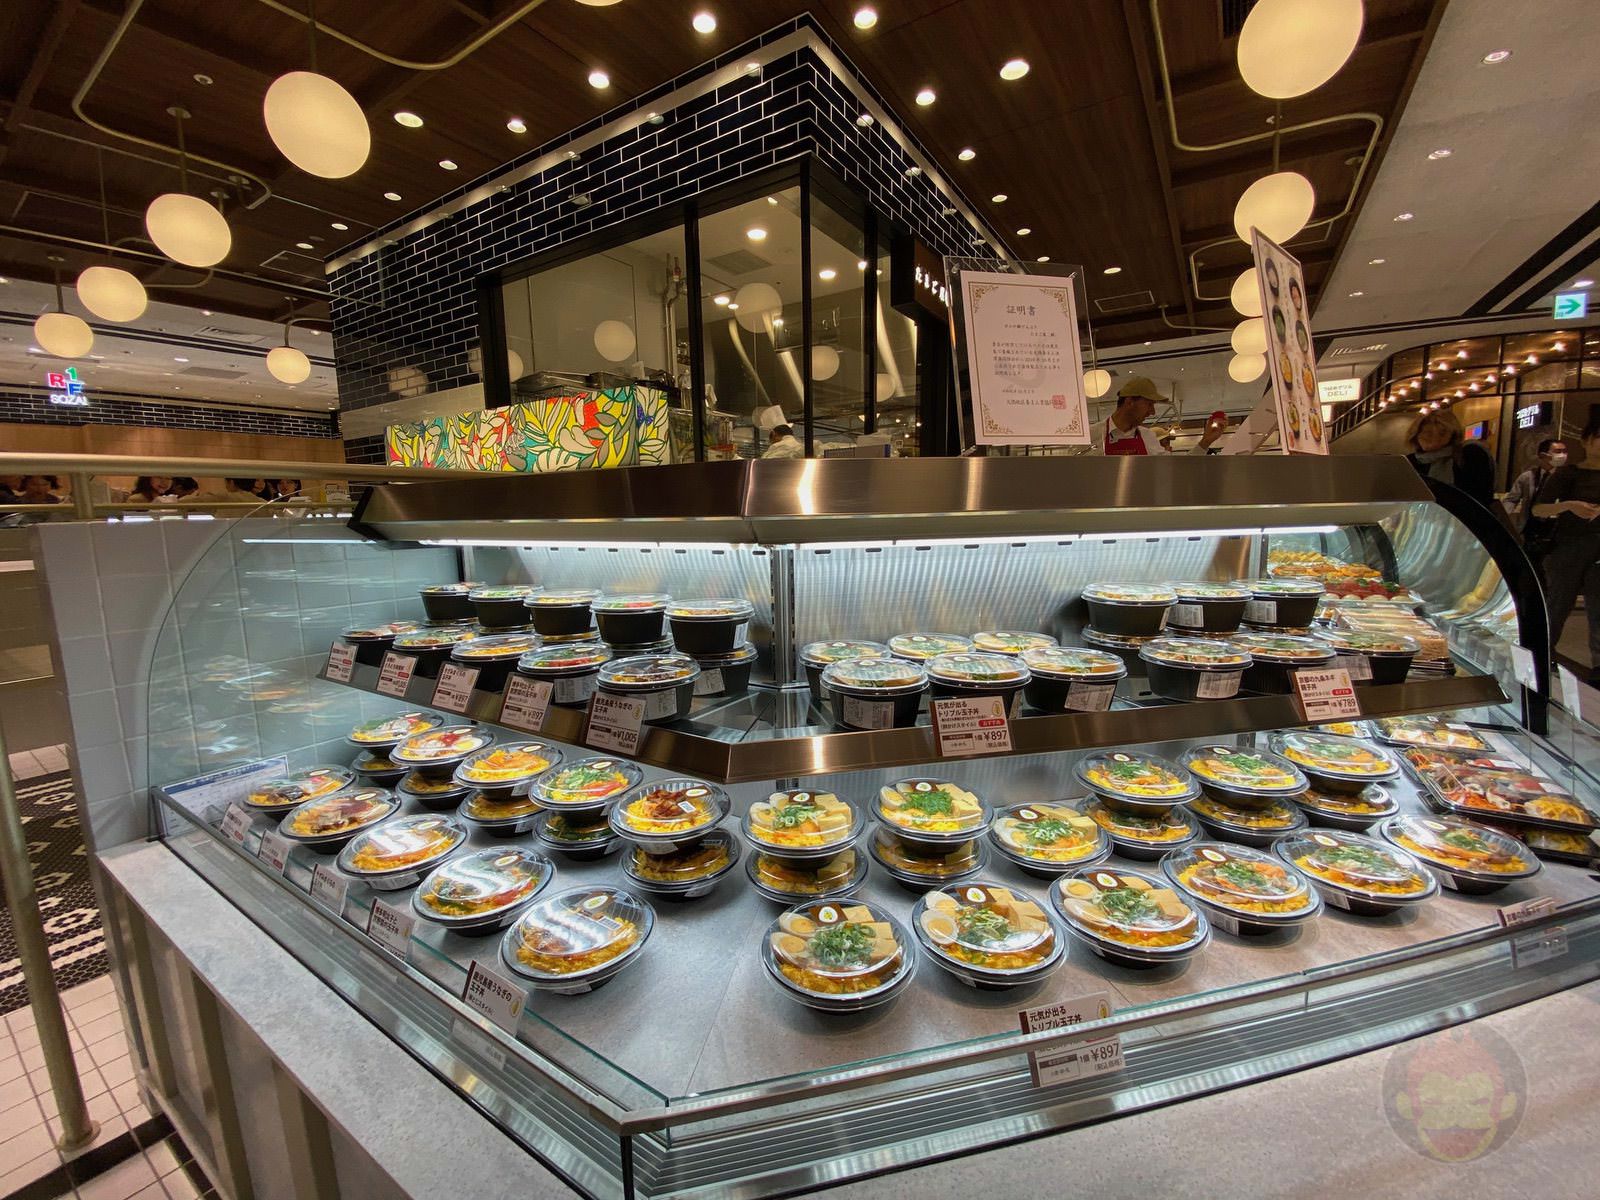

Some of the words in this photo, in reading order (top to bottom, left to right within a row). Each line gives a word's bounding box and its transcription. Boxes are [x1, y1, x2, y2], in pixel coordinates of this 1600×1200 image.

[1006, 305, 1036, 316] 証明書
[937, 701, 968, 710] 元気が出る
[1336, 698, 1356, 707] ¥789
[983, 730, 1008, 741] ¥897
[1029, 1005, 1067, 1022] 元気が出る
[1079, 1054, 1090, 1063] 1個
[1090, 1043, 1120, 1062] ¥897
